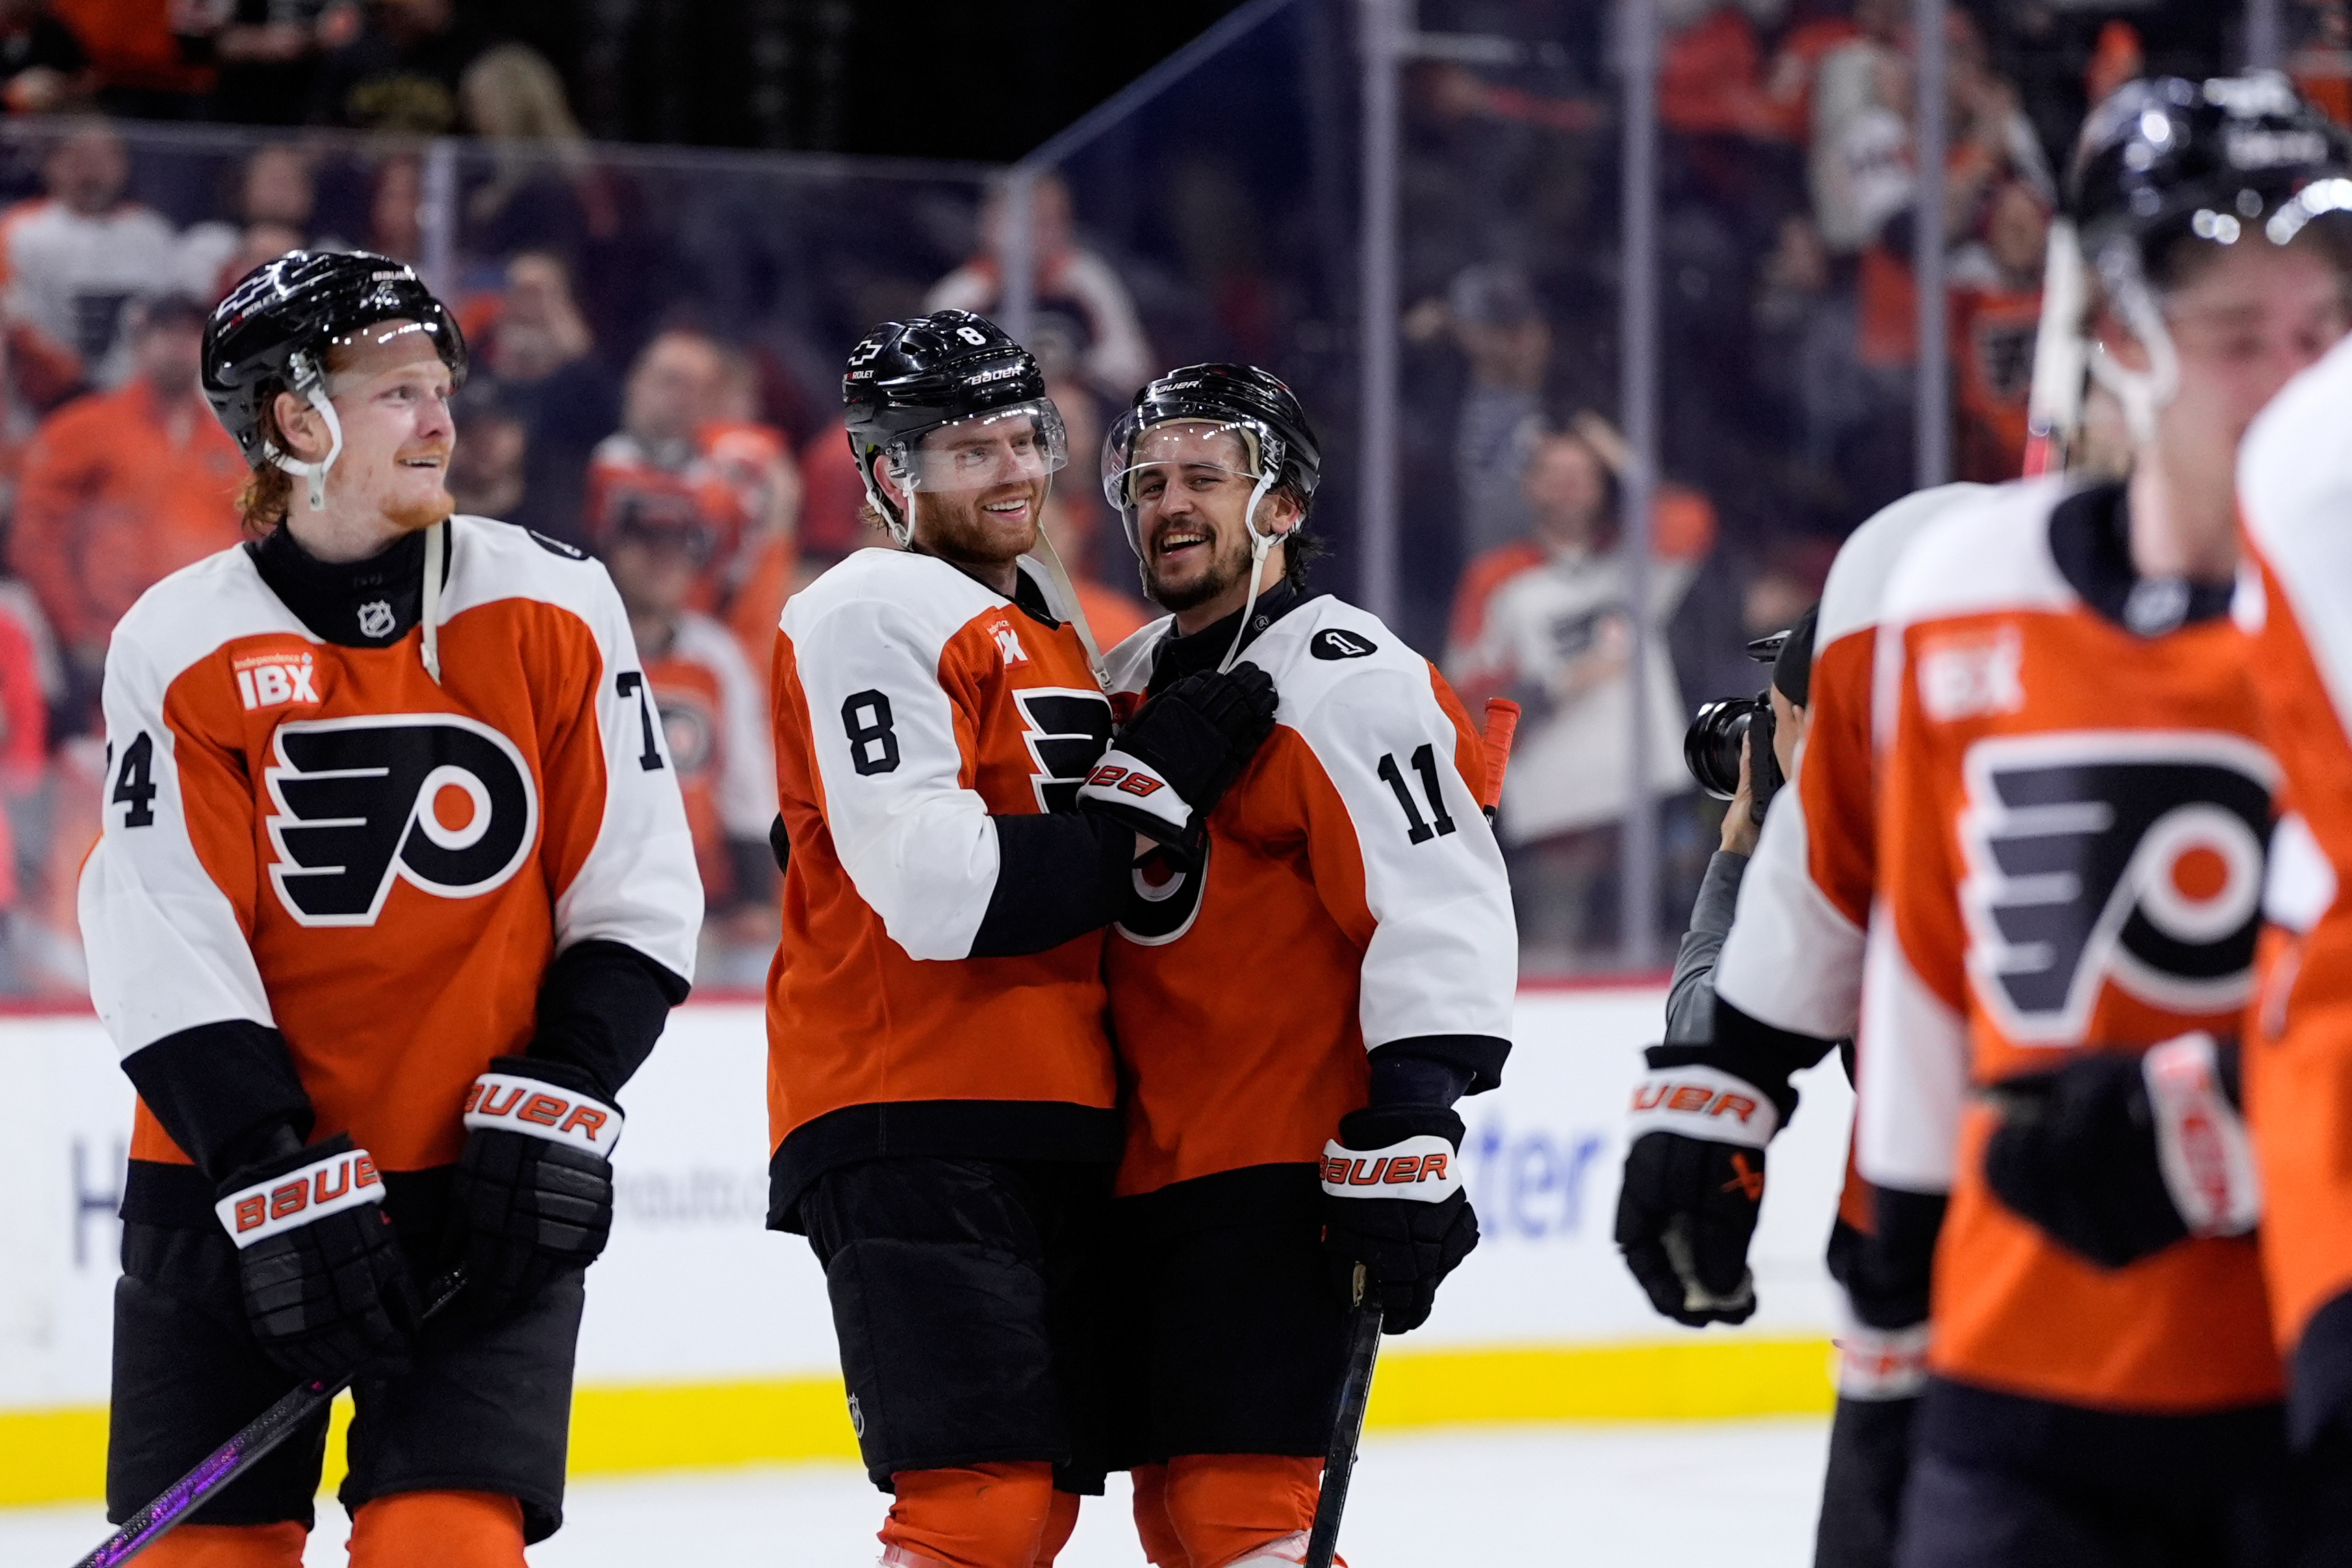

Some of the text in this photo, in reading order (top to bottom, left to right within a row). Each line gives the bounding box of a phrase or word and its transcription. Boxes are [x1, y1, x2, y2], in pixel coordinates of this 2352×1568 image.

[956, 326, 993, 346] 8
[1325, 632, 1366, 655] 1
[237, 664, 320, 711] IBX
[841, 689, 901, 777] 8
[1377, 743, 1457, 845] 11
